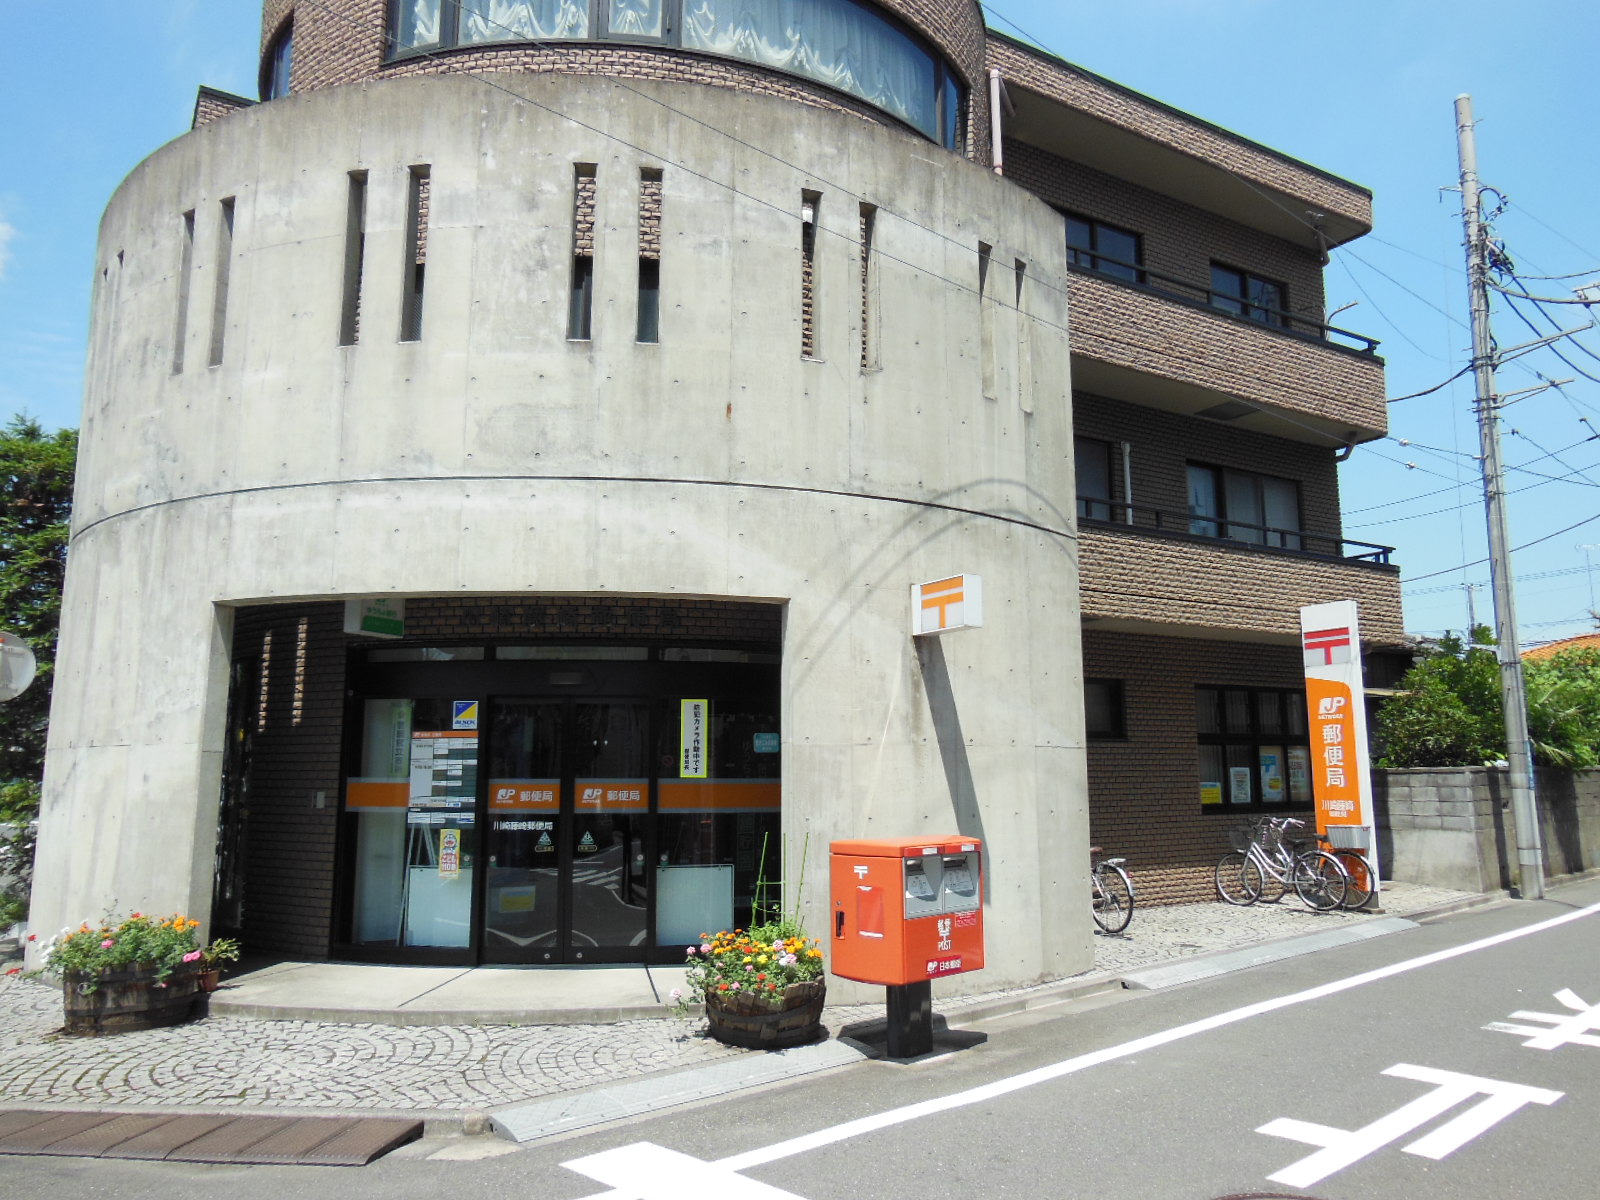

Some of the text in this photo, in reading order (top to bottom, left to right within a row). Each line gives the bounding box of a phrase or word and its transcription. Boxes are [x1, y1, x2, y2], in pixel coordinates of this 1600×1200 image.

[1322, 724, 1345, 788] 郵便局
[520, 790, 553, 802] 郵便局
[607, 790, 640, 801] 郵便局
[937, 940, 952, 951] POST
